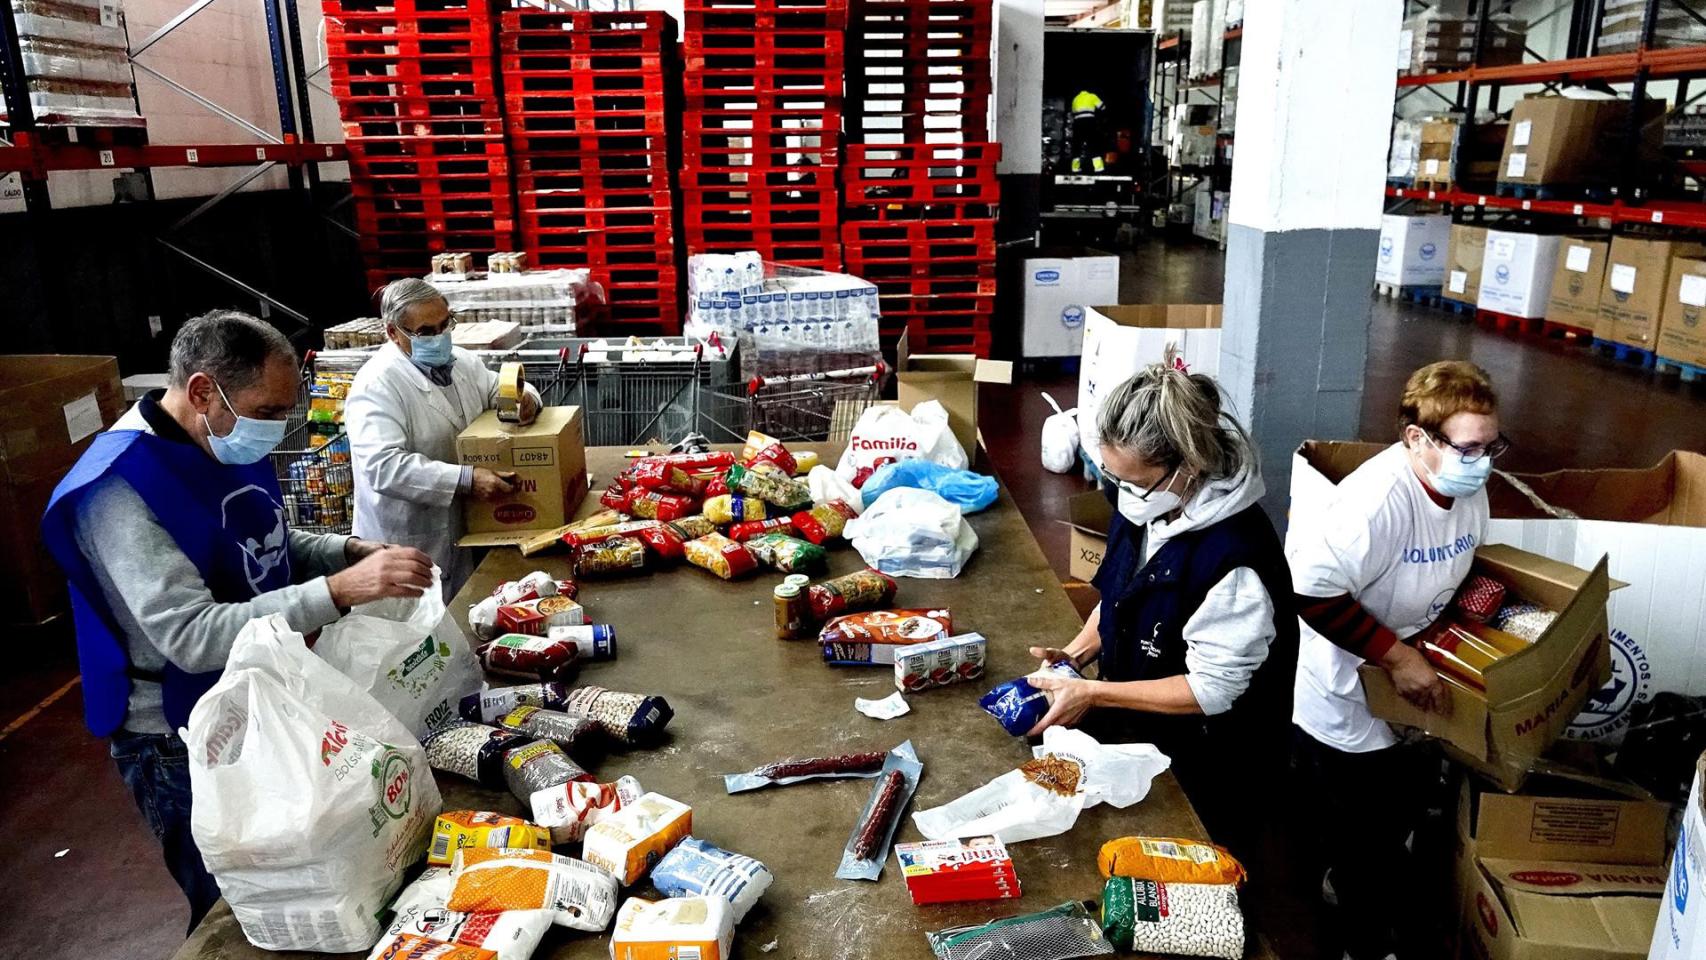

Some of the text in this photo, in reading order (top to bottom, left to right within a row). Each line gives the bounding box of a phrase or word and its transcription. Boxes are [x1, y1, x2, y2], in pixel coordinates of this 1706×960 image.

[103, 153, 113, 163] 20
[520, 452, 549, 462] 48407
[852, 436, 917, 451] Familia
[1610, 628, 1652, 680] IMENTOS
[424, 698, 451, 731] FROIZ
[1514, 690, 1569, 736] MARIA
[386, 769, 408, 804] 80%
